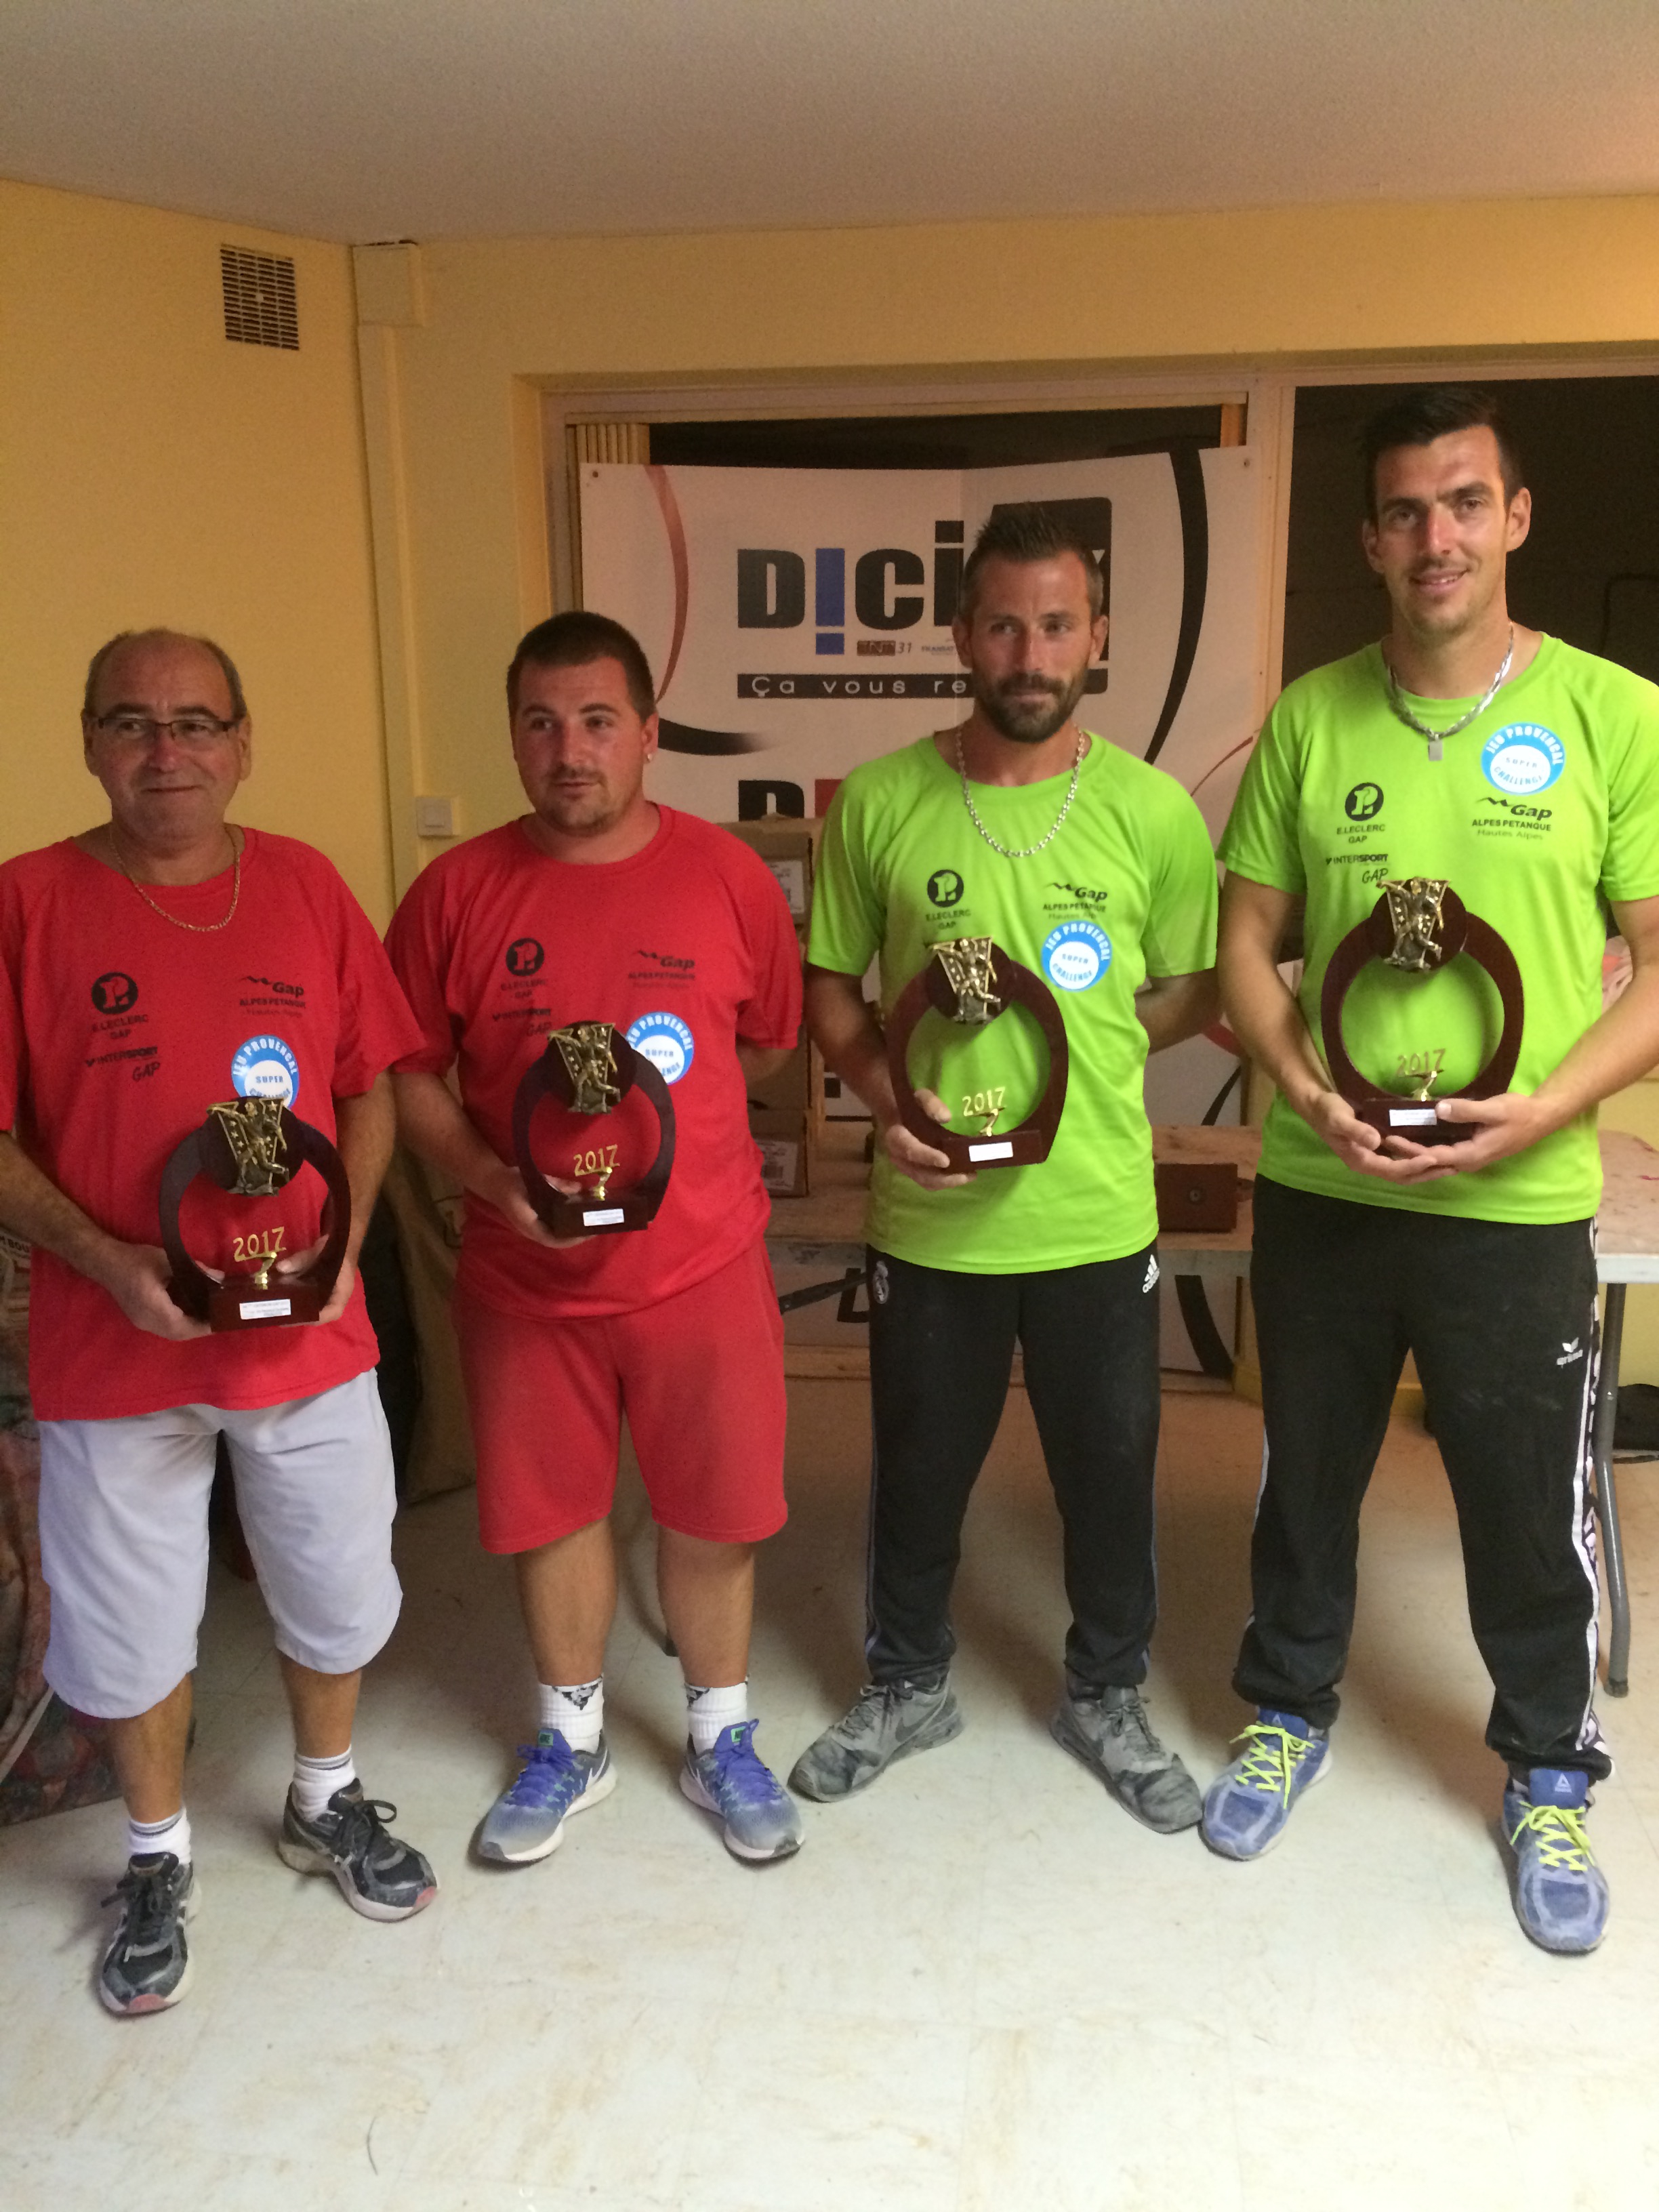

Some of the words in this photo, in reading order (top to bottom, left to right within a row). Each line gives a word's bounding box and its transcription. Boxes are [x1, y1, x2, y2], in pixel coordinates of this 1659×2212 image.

[751, 676, 795, 697] Ça
[822, 680, 906, 694] vous
[934, 680, 968, 694] re
[1511, 804, 1553, 821] Gap
[1477, 829, 1513, 837] Hautes
[1502, 819, 1551, 832] PETANQUE
[1348, 835, 1368, 844] GAP
[1333, 853, 1389, 864] INTERSPORT
[1362, 867, 1389, 884] GAP
[1075, 887, 1107, 903] Gap
[660, 956, 695, 970] Gap
[272, 982, 304, 998] Gap
[1397, 1048, 1446, 1078] 2017
[132, 1061, 161, 1082] GAP
[255, 1076, 283, 1084] SUPER
[962, 1086, 1006, 1117] 2017
[573, 1144, 620, 1176] 2017
[232, 1226, 287, 1262] 2017
